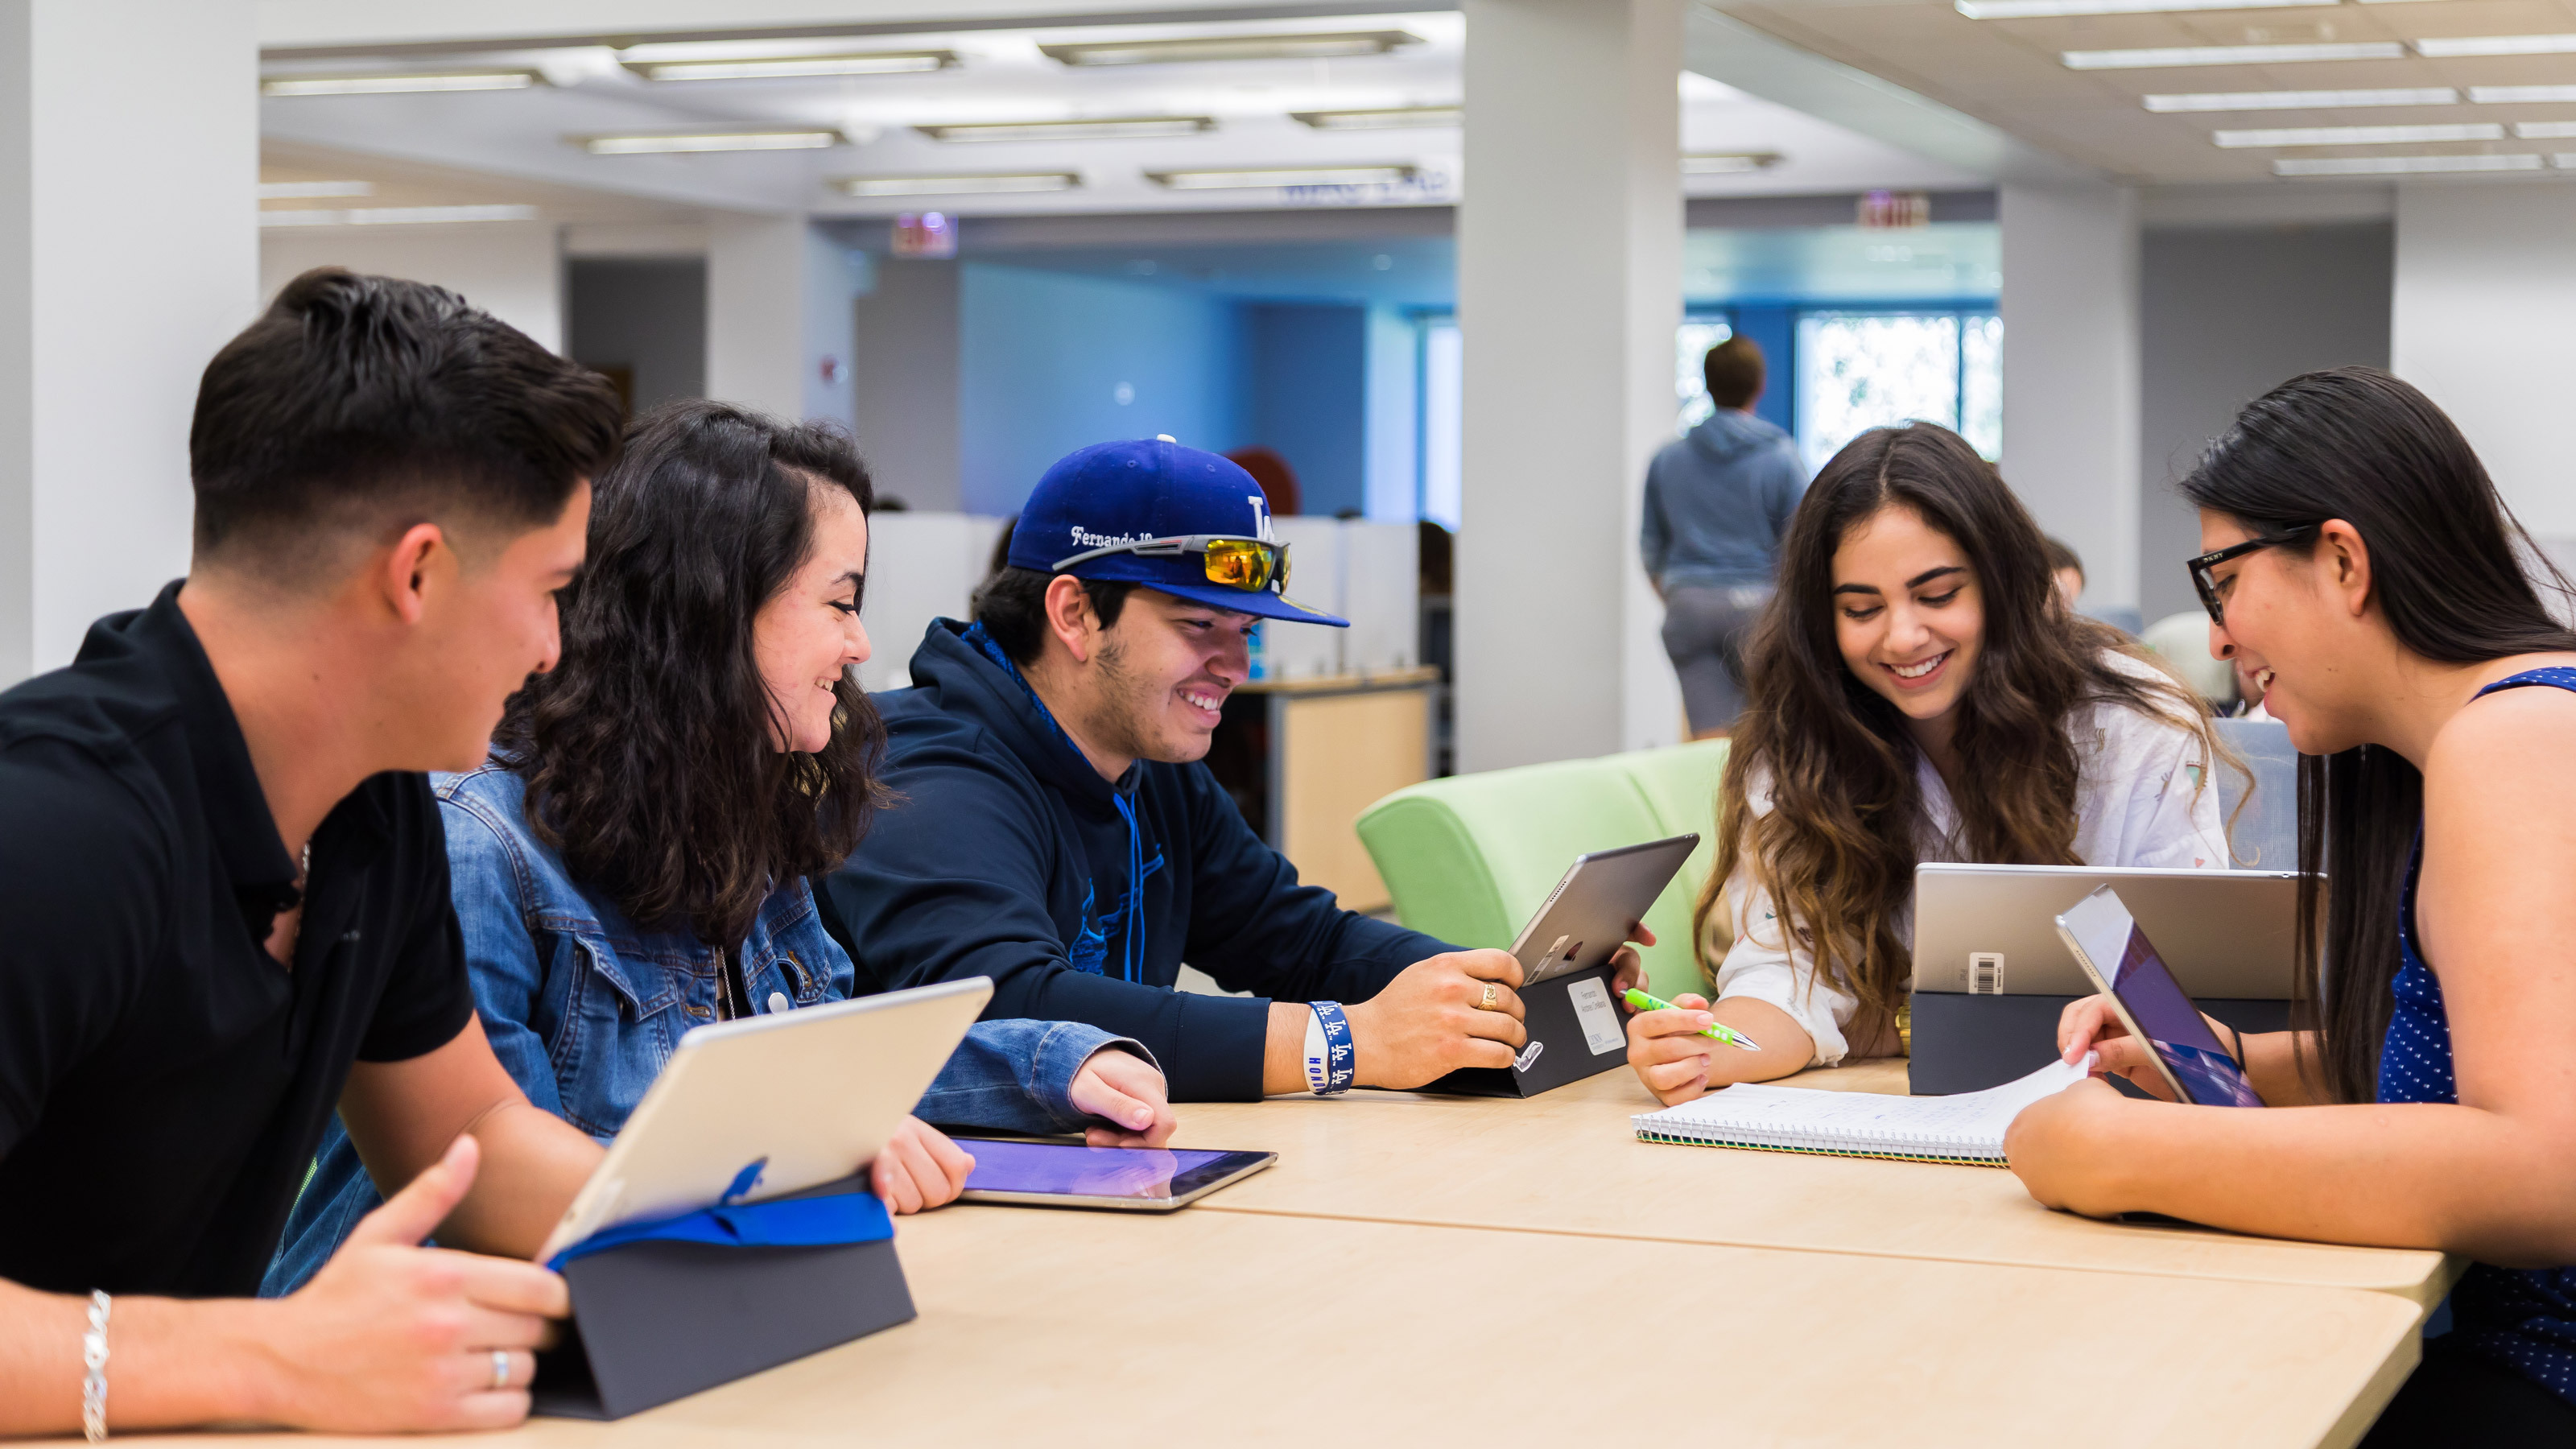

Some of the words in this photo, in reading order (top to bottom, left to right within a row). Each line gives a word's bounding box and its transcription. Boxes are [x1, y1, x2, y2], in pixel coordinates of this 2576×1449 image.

[1325, 1020, 1346, 1035] LA
[1331, 1043, 1352, 1061] LA
[1331, 1068, 1352, 1084] LA
